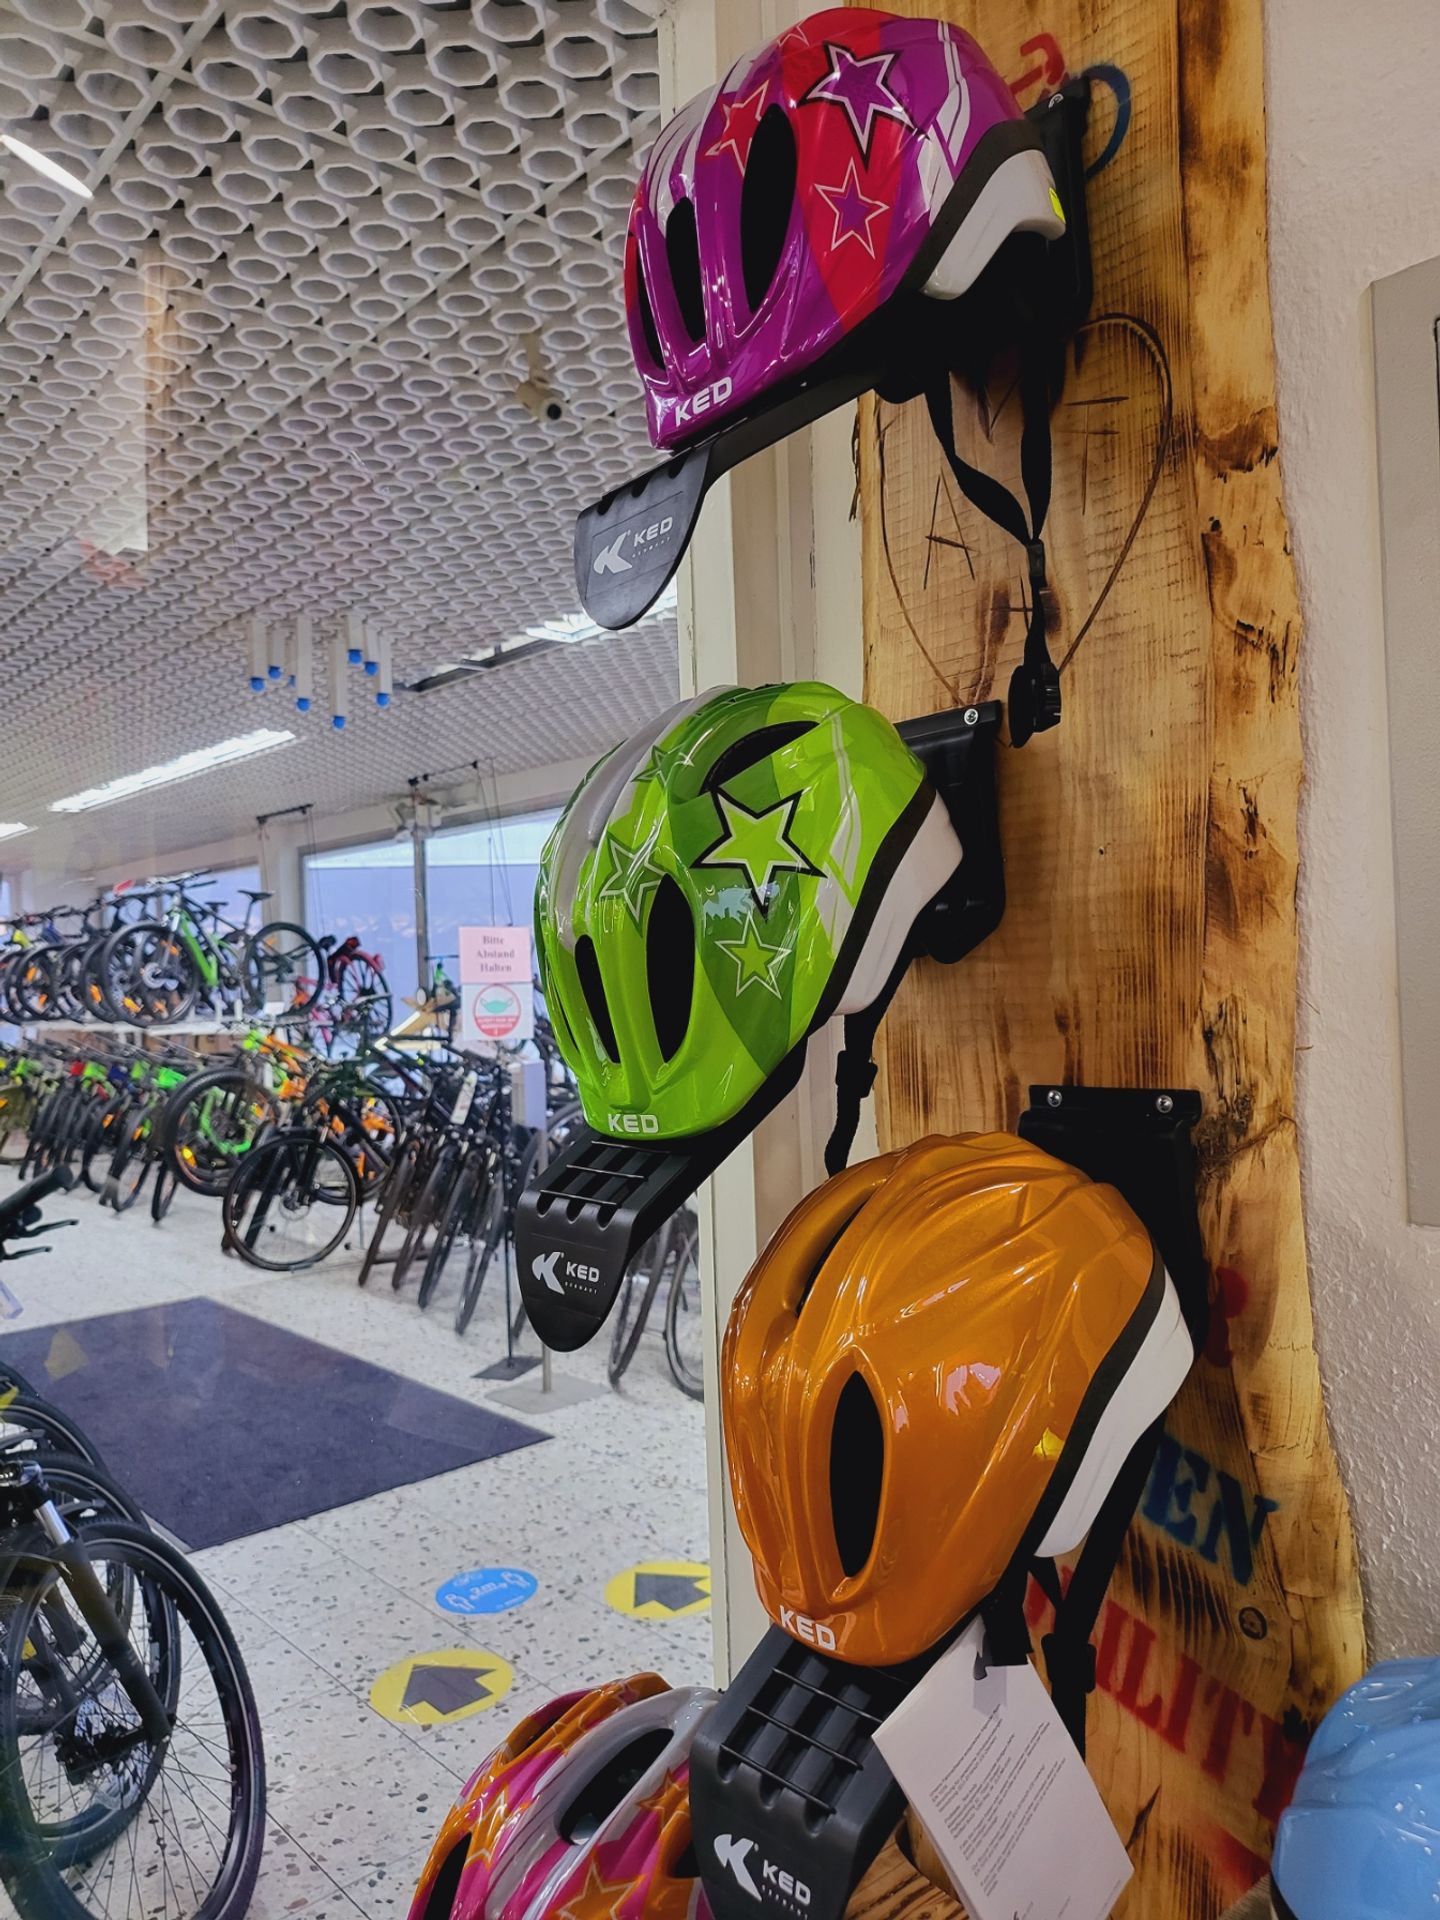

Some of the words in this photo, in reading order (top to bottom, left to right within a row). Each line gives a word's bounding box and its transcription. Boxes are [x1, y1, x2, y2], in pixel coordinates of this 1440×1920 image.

[675, 376, 733, 428] KED
[633, 516, 673, 547] KED
[482, 935, 505, 945] Bitte
[607, 1113, 659, 1134] KED
[566, 1261, 600, 1282] KED
[779, 1604, 836, 1651] KED
[763, 1859, 811, 1906] KED
